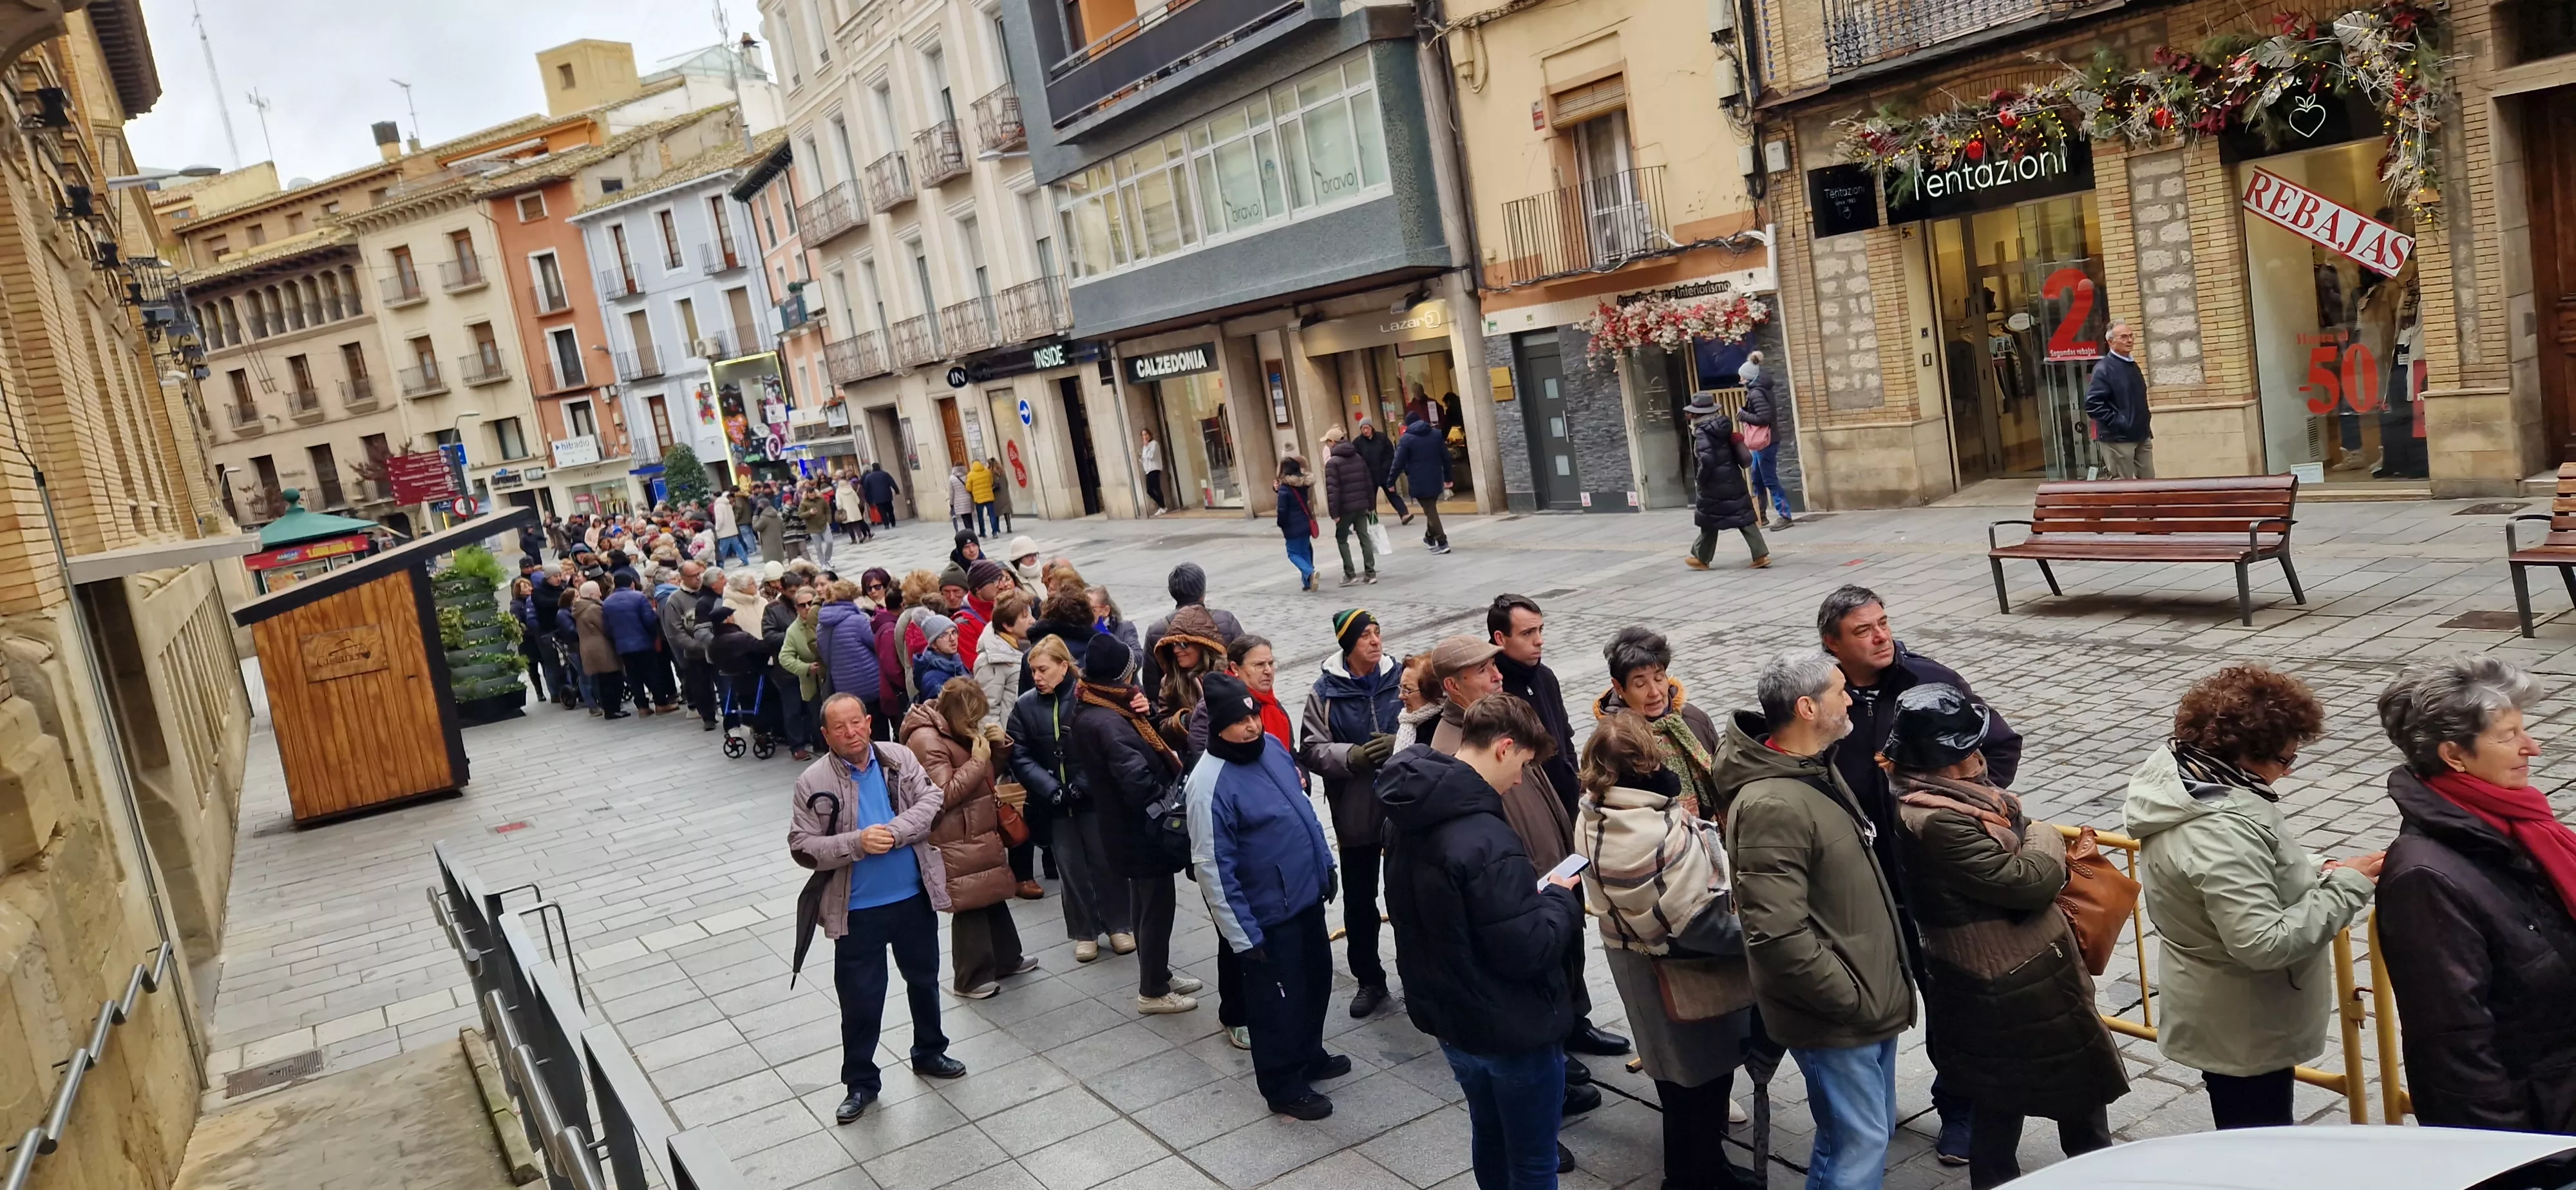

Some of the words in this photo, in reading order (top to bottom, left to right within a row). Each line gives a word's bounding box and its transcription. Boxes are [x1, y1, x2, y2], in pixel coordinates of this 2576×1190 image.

[1914, 149, 2067, 201] Tentazioni
[1824, 185, 1865, 199] Tentazioni
[2242, 170, 2414, 270] REBAJAS
[1676, 280, 1731, 300] Interiorismo
[2041, 268, 2098, 357] 2
[1032, 344, 1066, 369] INSIDE
[1135, 348, 1208, 378] CALZEDONIA
[2050, 348, 2075, 357] Segundas
[2076, 347, 2096, 356] rebajas
[950, 372, 965, 384] IN
[560, 439, 590, 450] hitradio
